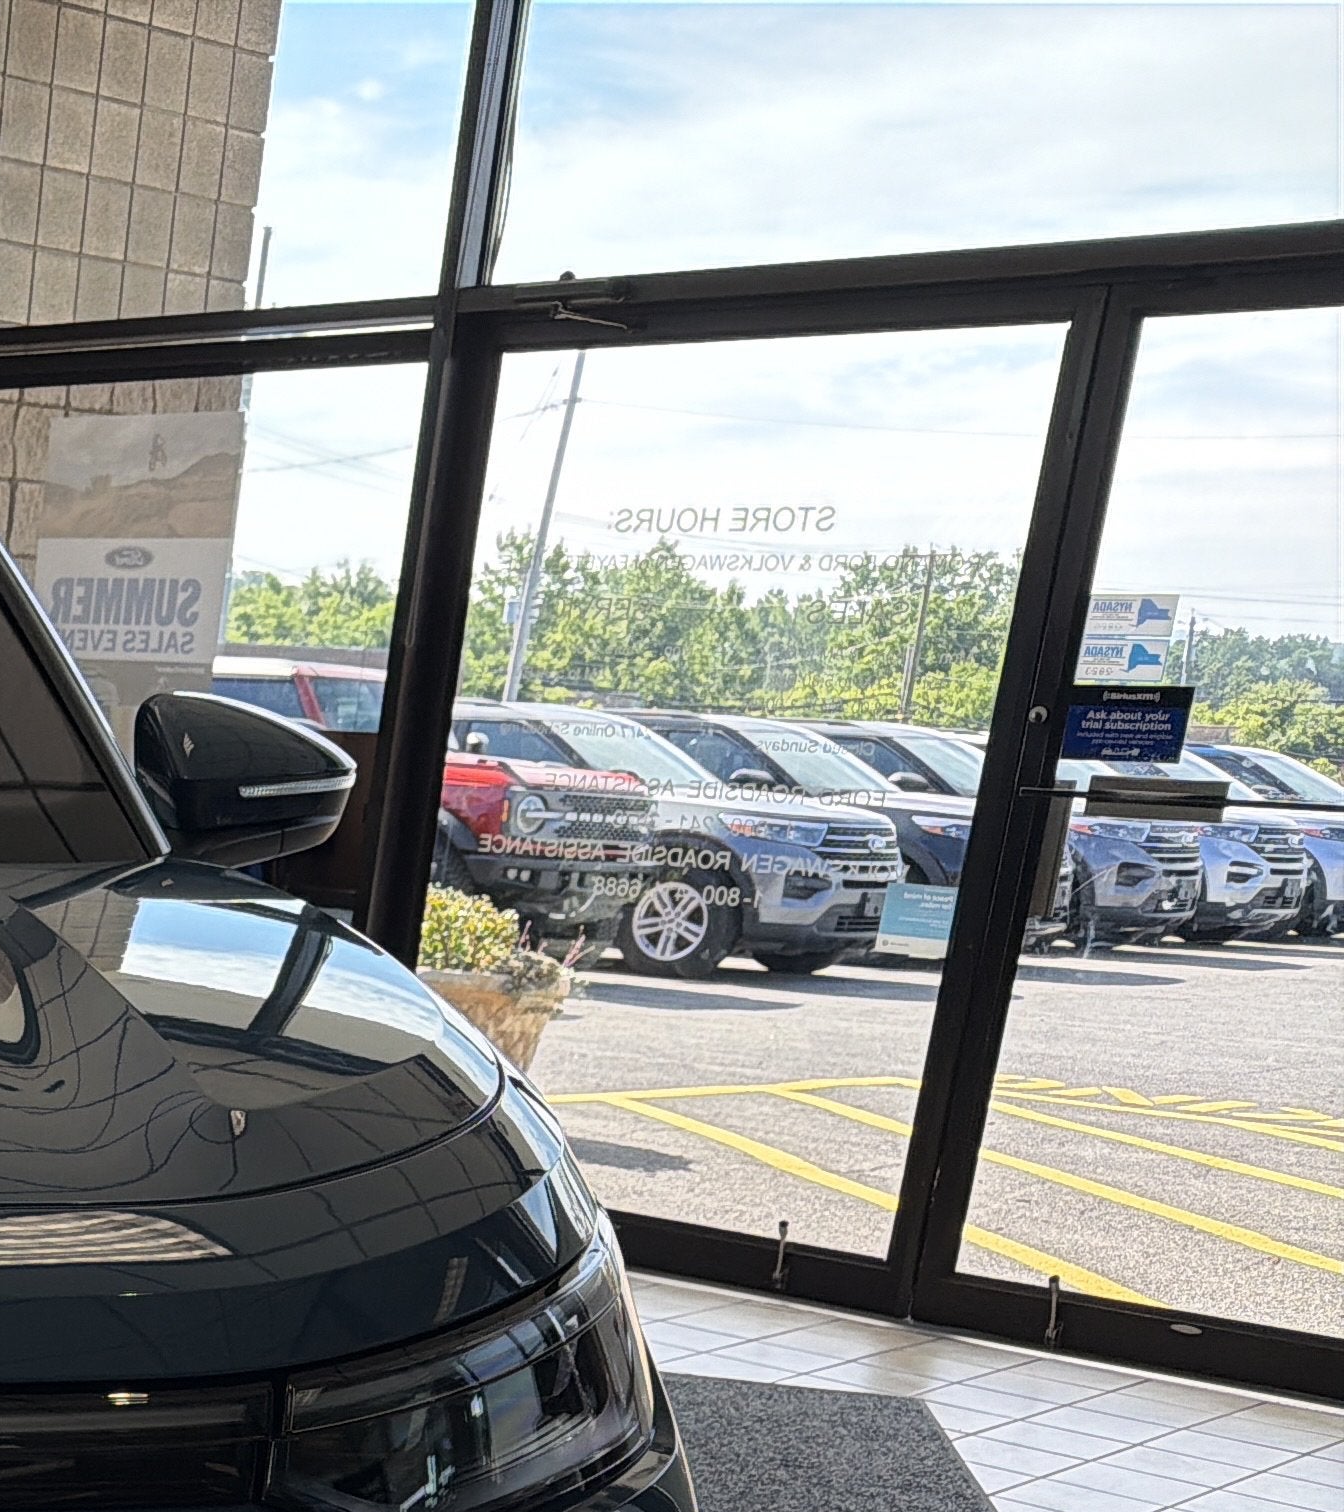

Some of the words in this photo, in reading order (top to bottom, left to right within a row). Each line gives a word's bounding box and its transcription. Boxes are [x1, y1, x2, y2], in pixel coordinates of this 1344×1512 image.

[1086, 710, 1108, 720] Ask
[1110, 710, 1143, 721] about
[1145, 711, 1170, 722] your
[1081, 721, 1103, 730] trial
[1104, 720, 1172, 731] subscription
